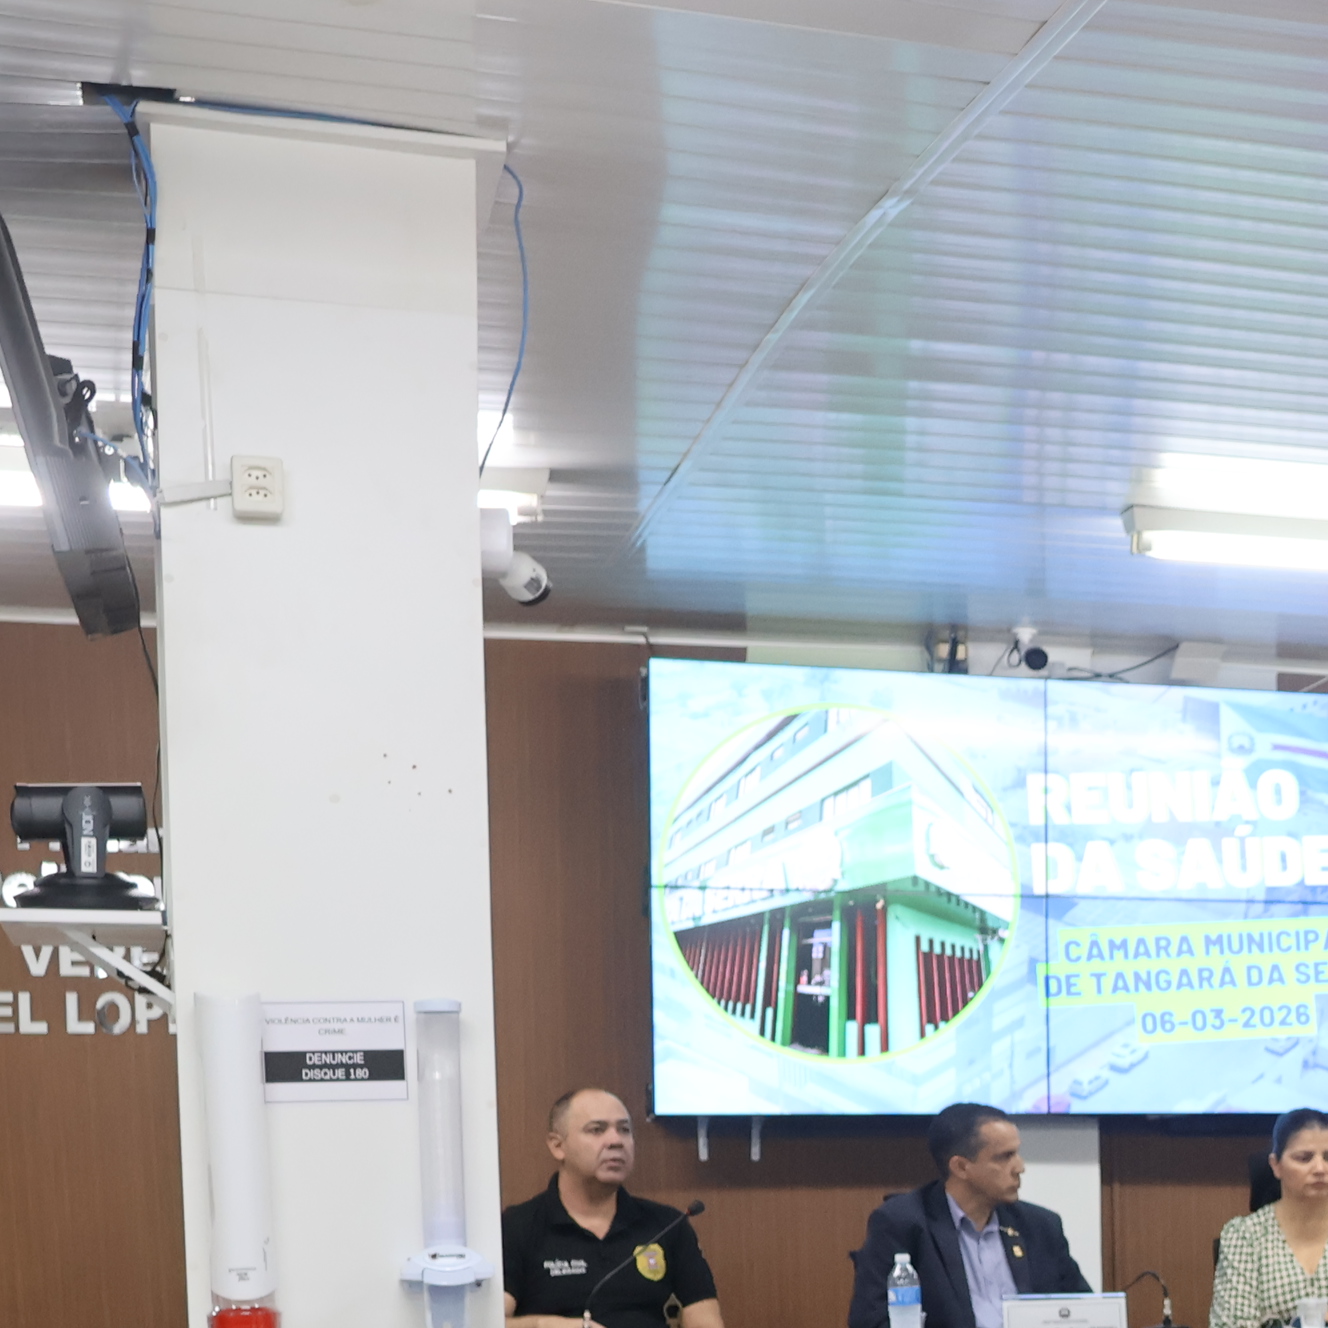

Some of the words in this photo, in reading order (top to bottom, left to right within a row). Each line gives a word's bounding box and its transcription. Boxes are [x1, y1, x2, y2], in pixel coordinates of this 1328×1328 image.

[1026, 758, 1300, 826] REUNIÃO
[1030, 840, 1125, 896] DA
[1063, 932, 1195, 964] CÂMARA
[1044, 973, 1082, 999] DE
[1090, 962, 1238, 996] TANGARÁ
[1246, 964, 1287, 988] DA
[65, 990, 178, 1035] LOP
[312, 1016, 348, 1024] CONTRA
[356, 1015, 392, 1024] MULHER
[1140, 1003, 1311, 1036] 06-03-2026
[318, 1028, 346, 1036] CRIME
[302, 1068, 346, 1080] DISQUE
[349, 1068, 369, 1080] 180
[306, 1052, 364, 1065] DENUNCIE
